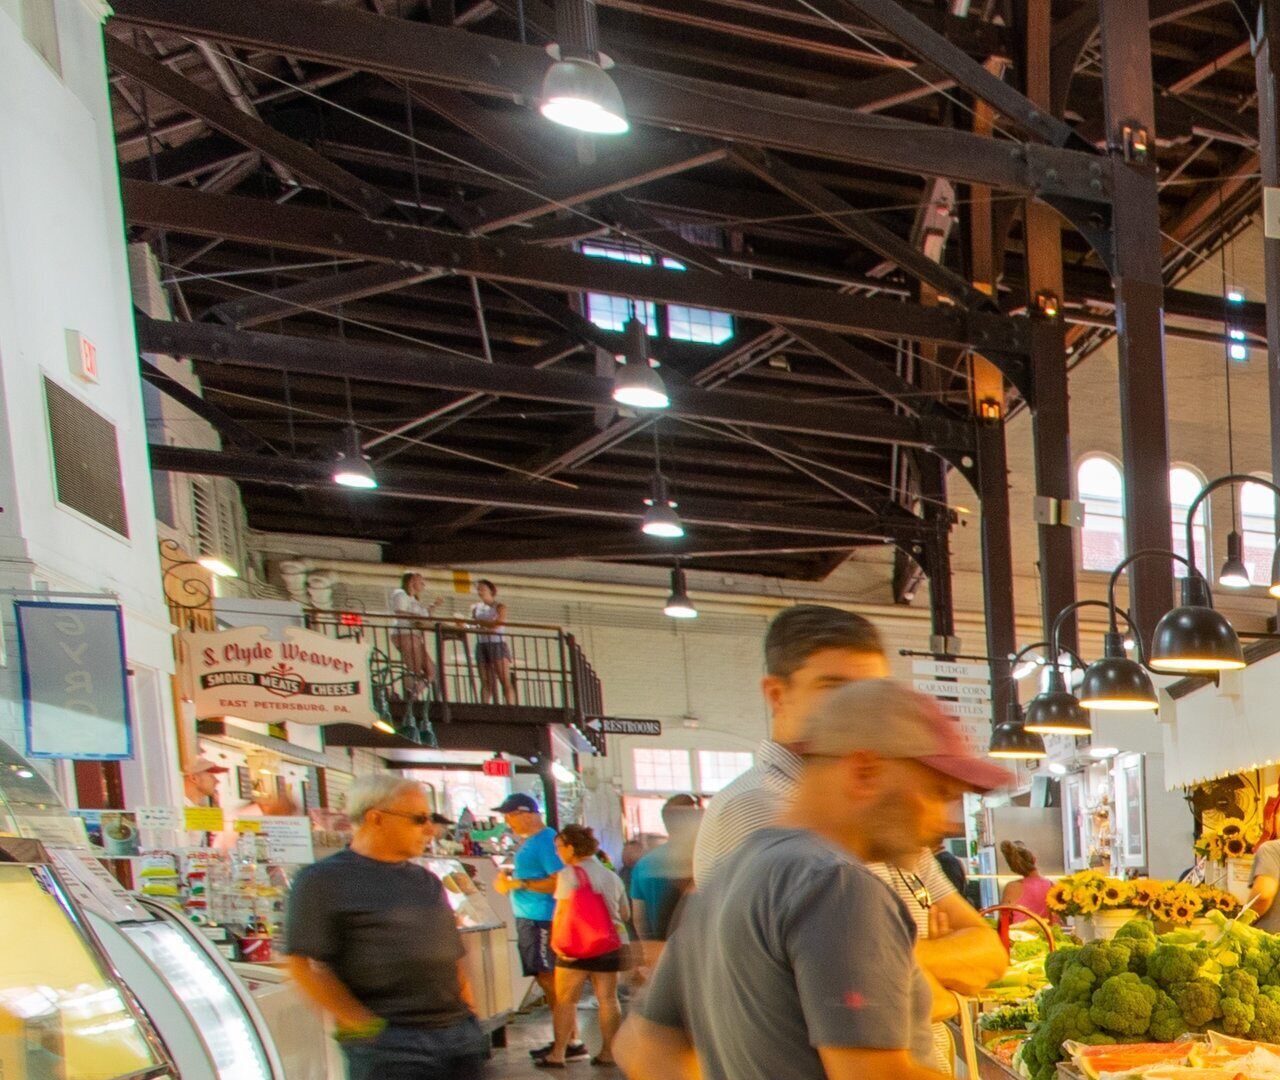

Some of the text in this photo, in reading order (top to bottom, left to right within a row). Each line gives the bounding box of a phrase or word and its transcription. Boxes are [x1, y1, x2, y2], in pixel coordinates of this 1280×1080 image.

[223, 642, 273, 666] Clyde
[280, 642, 354, 673] Weaver
[935, 664, 968, 675] FUDGE
[207, 673, 354, 695] SMOKED MEATS CHEESE
[962, 686, 986, 695] CORN
[219, 700, 248, 708] EAST
[604, 720, 660, 733] RESTROOMS
